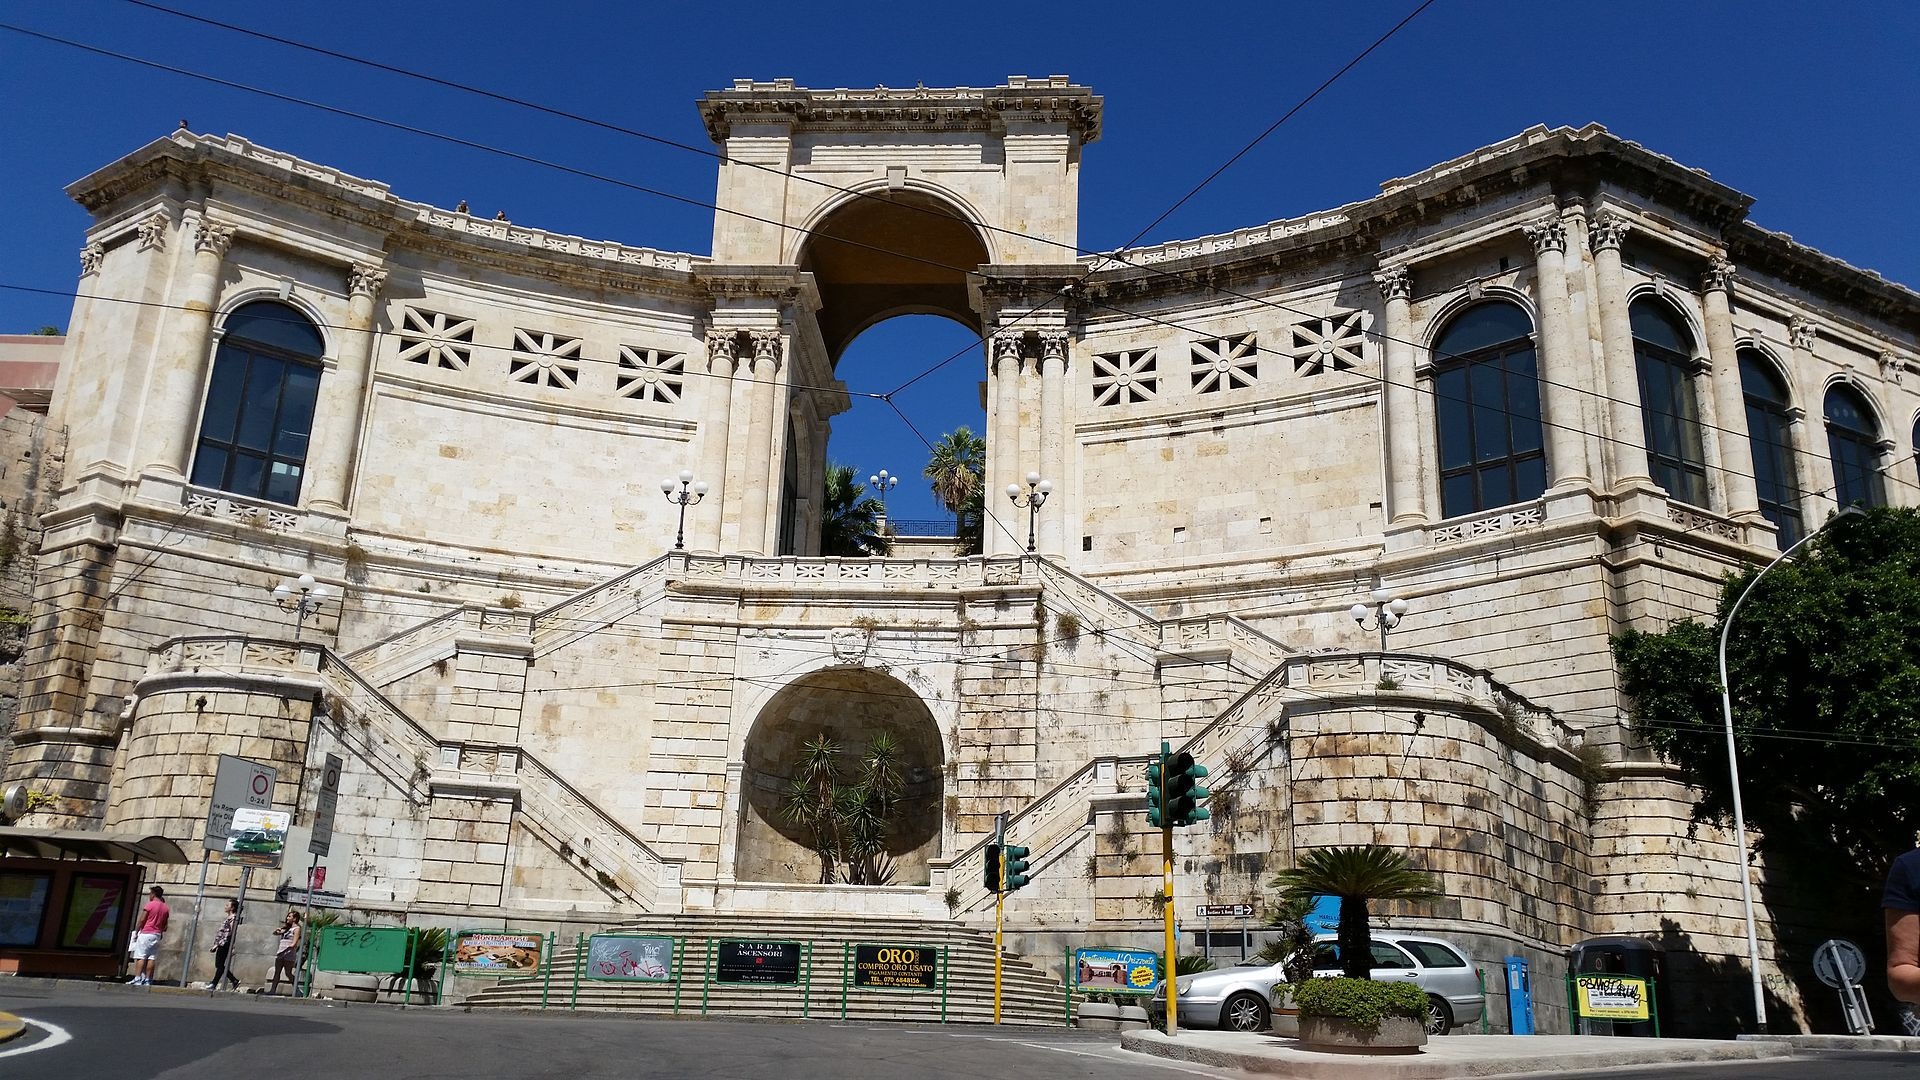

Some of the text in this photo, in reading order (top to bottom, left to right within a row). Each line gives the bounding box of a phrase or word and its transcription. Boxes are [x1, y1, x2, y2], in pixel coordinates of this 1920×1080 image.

[250, 796, 265, 805] 0-24
[221, 804, 236, 812] Rom
[877, 948, 915, 964] ORO
[858, 962, 934, 972] COMPRO ORO USATO
